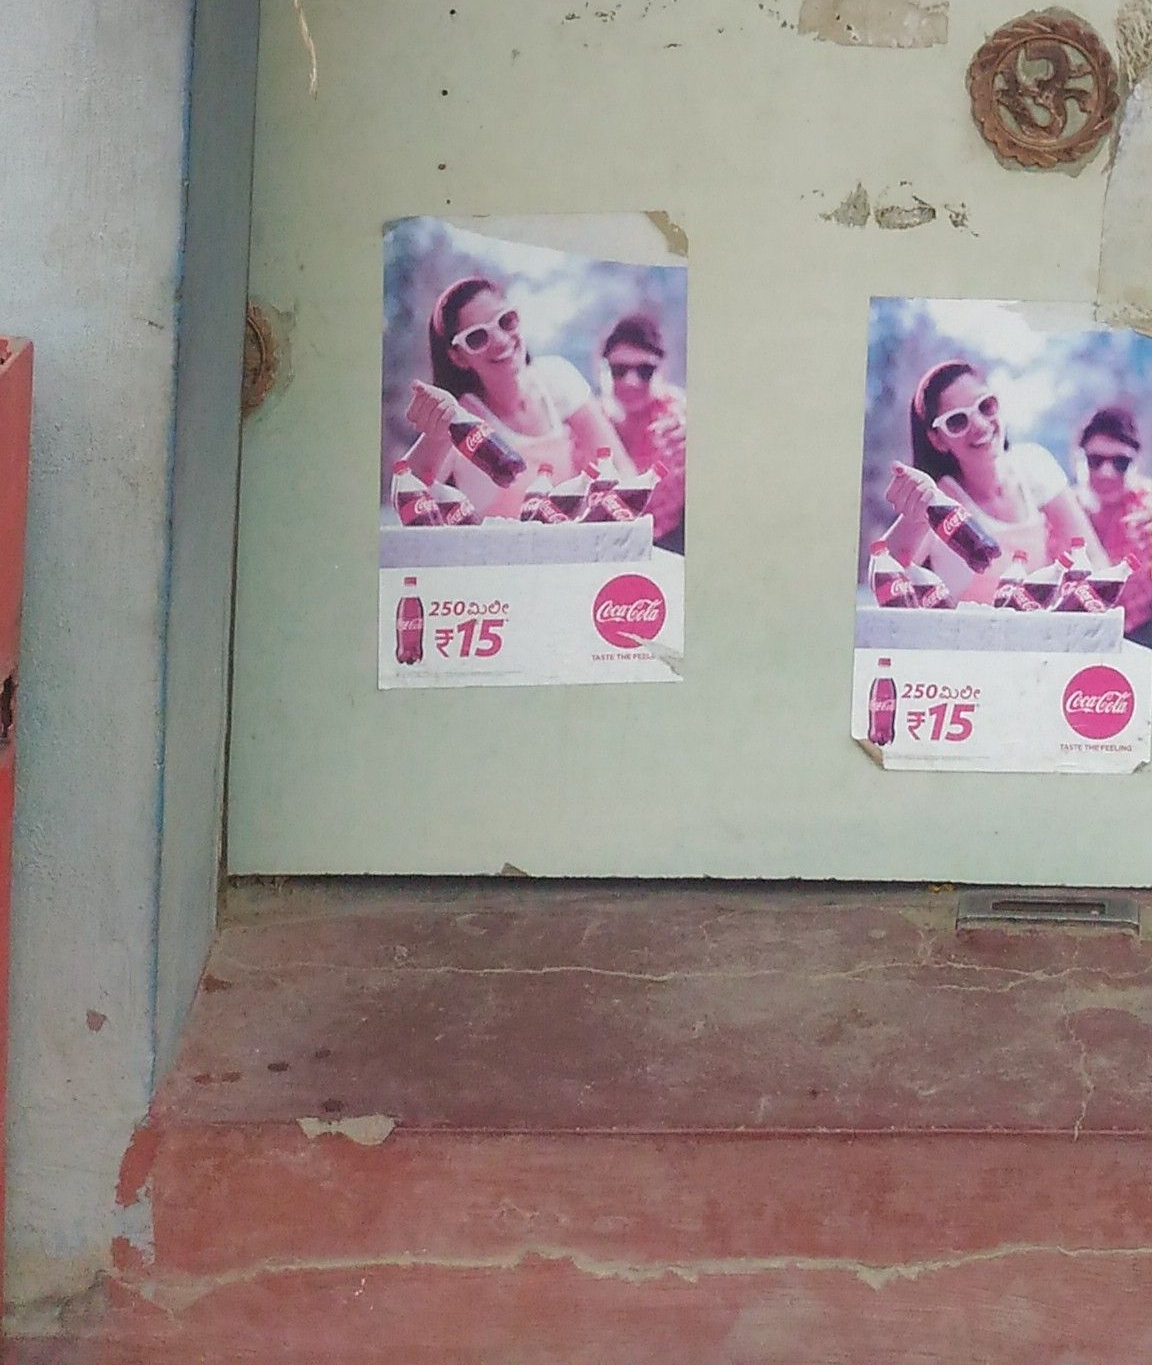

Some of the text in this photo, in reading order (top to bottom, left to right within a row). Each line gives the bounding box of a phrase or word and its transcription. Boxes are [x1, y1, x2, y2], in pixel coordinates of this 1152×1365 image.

[596, 597, 664, 625] Coca-Cola
[591, 652, 615, 662] TASTE
[616, 652, 632, 661] THE
[1065, 689, 1132, 716] Coca-Cola
[1060, 743, 1133, 753] TASTE THE FEELING
